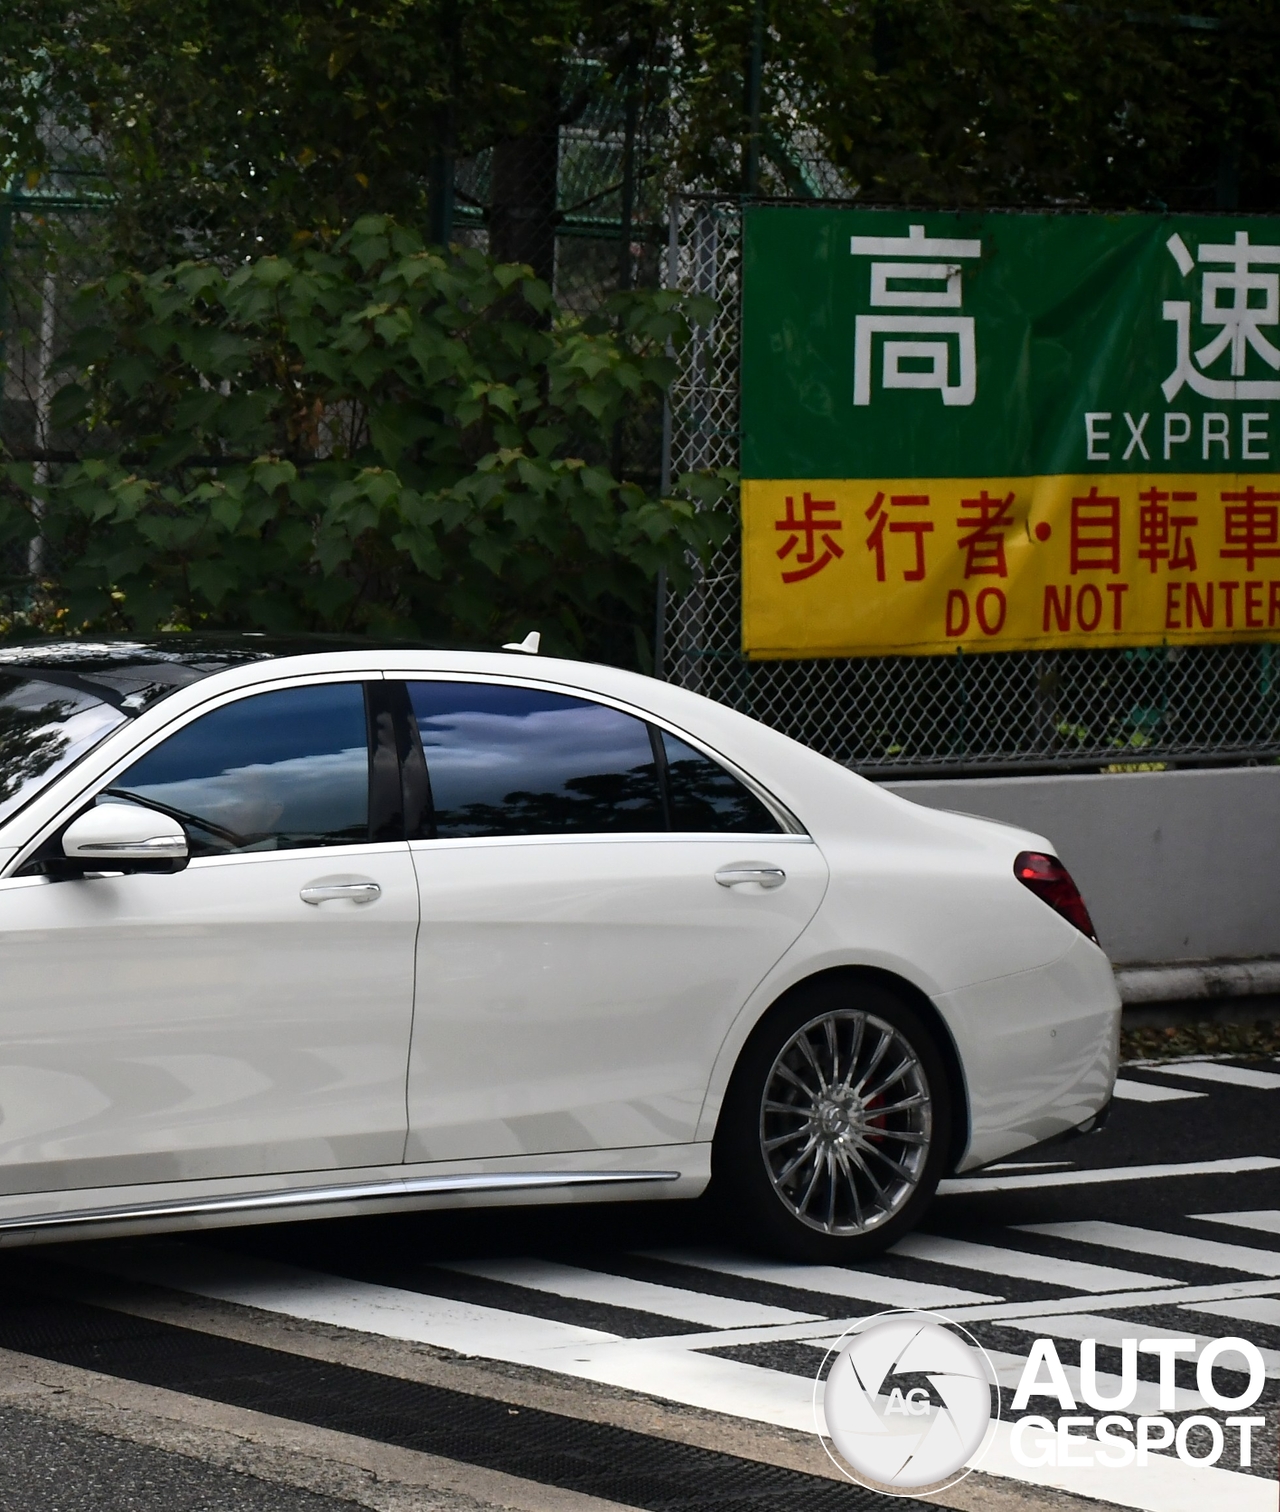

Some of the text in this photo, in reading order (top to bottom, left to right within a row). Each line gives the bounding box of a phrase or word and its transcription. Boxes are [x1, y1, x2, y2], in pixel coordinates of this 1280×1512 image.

[1084, 412, 1270, 460] EXPRE
[945, 587, 1007, 637] DO
[1043, 583, 1129, 632] NOT
